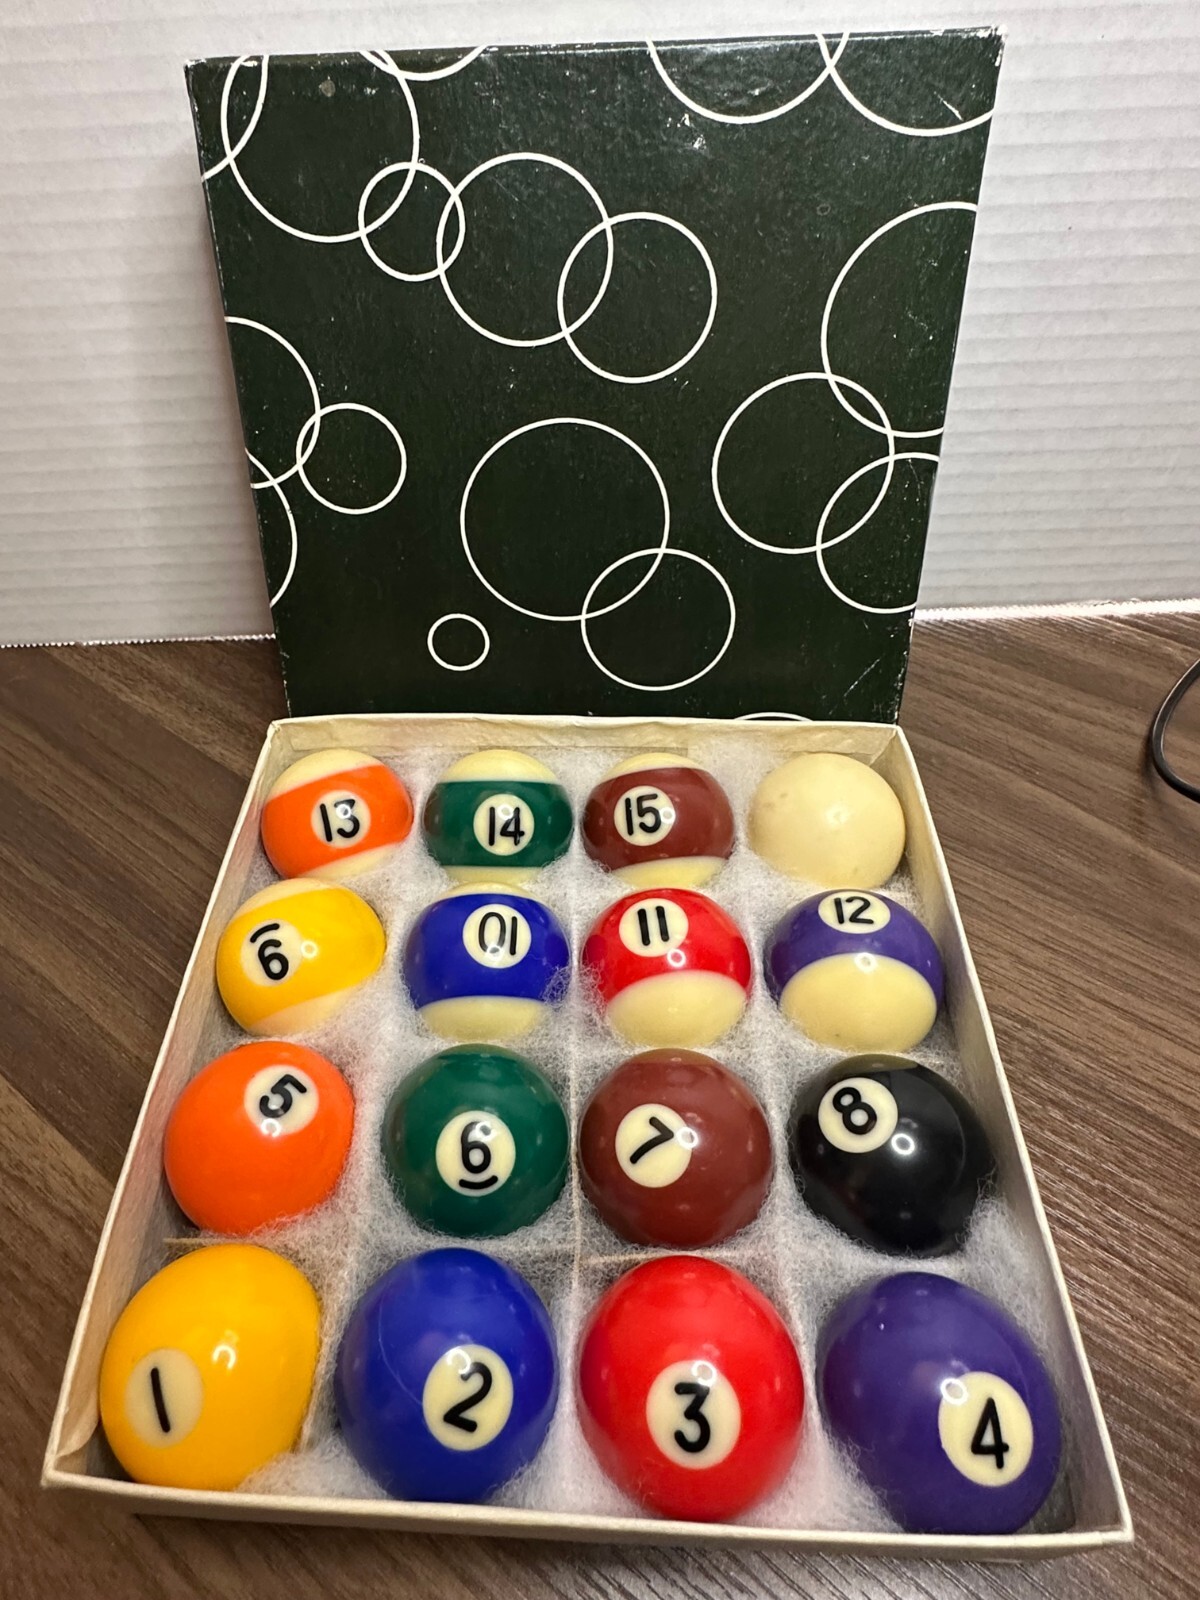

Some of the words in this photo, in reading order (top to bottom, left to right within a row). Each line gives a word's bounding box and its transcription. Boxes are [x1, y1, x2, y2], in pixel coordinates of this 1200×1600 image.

[320, 798, 360, 842] 13
[488, 806, 525, 846] 14
[624, 793, 661, 837] 15
[637, 905, 670, 946] 11
[833, 896, 875, 925] 12
[259, 1074, 307, 1119] 5
[832, 1086, 878, 1135] 8
[459, 1121, 498, 1190] 6
[629, 1116, 674, 1165] 7
[150, 1367, 171, 1433] 1
[443, 1361, 493, 1433] 2
[674, 1381, 711, 1453] 3
[971, 1397, 1010, 1470] 4
